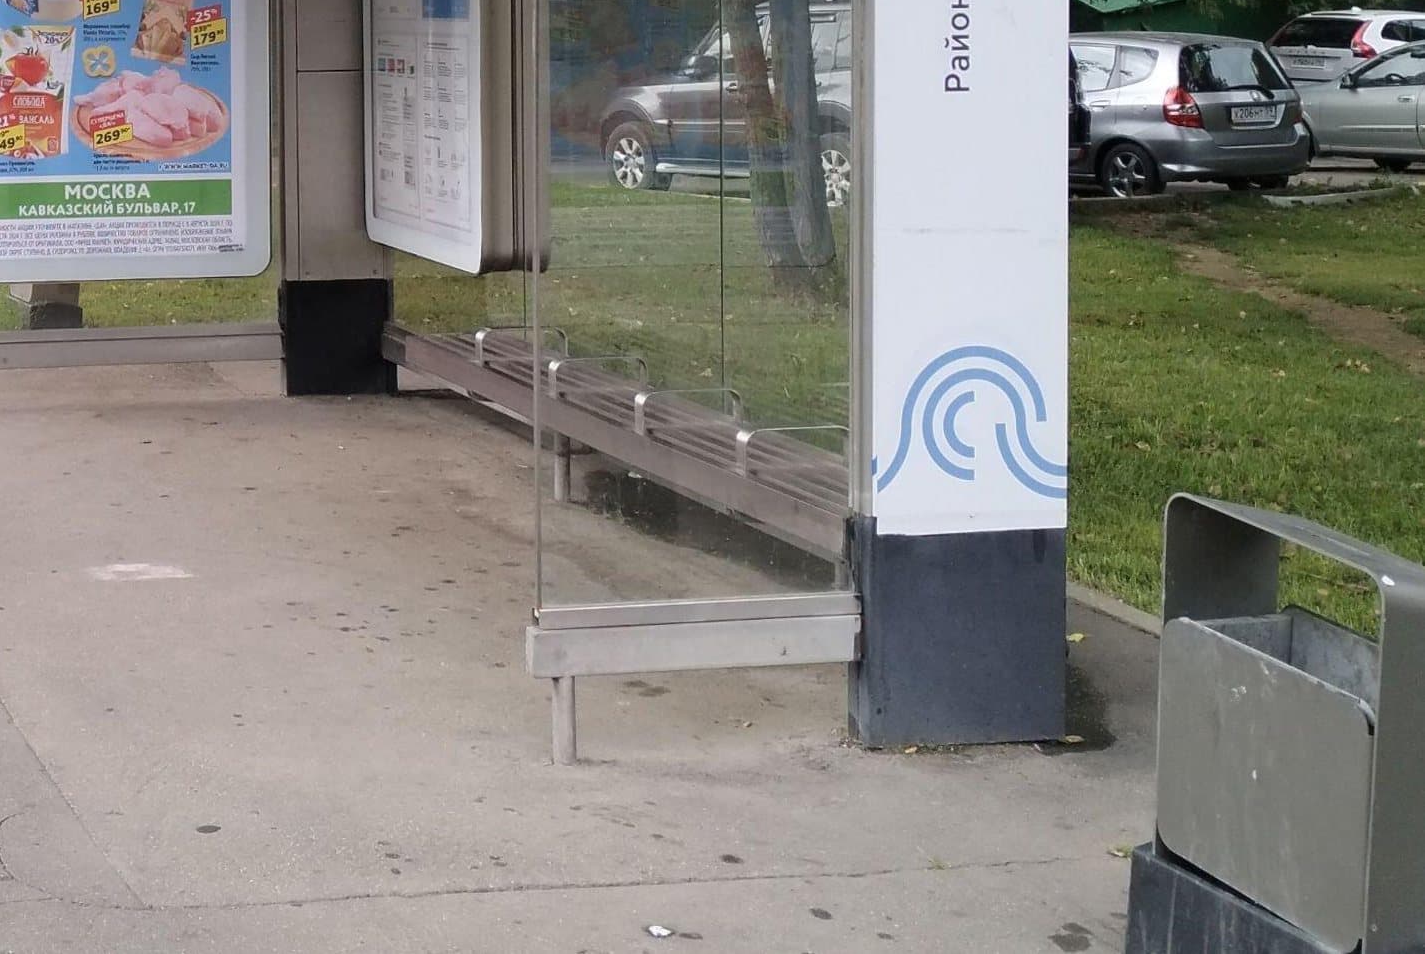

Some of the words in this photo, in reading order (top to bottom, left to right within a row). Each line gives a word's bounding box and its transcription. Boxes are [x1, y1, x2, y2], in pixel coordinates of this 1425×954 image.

[64, 183, 151, 200] МОСКВА
[18, 199, 113, 217] КАВКАЗСКИЙ
[116, 202, 182, 215] БУЛЬВАР,
[184, 202, 196, 213] 17
